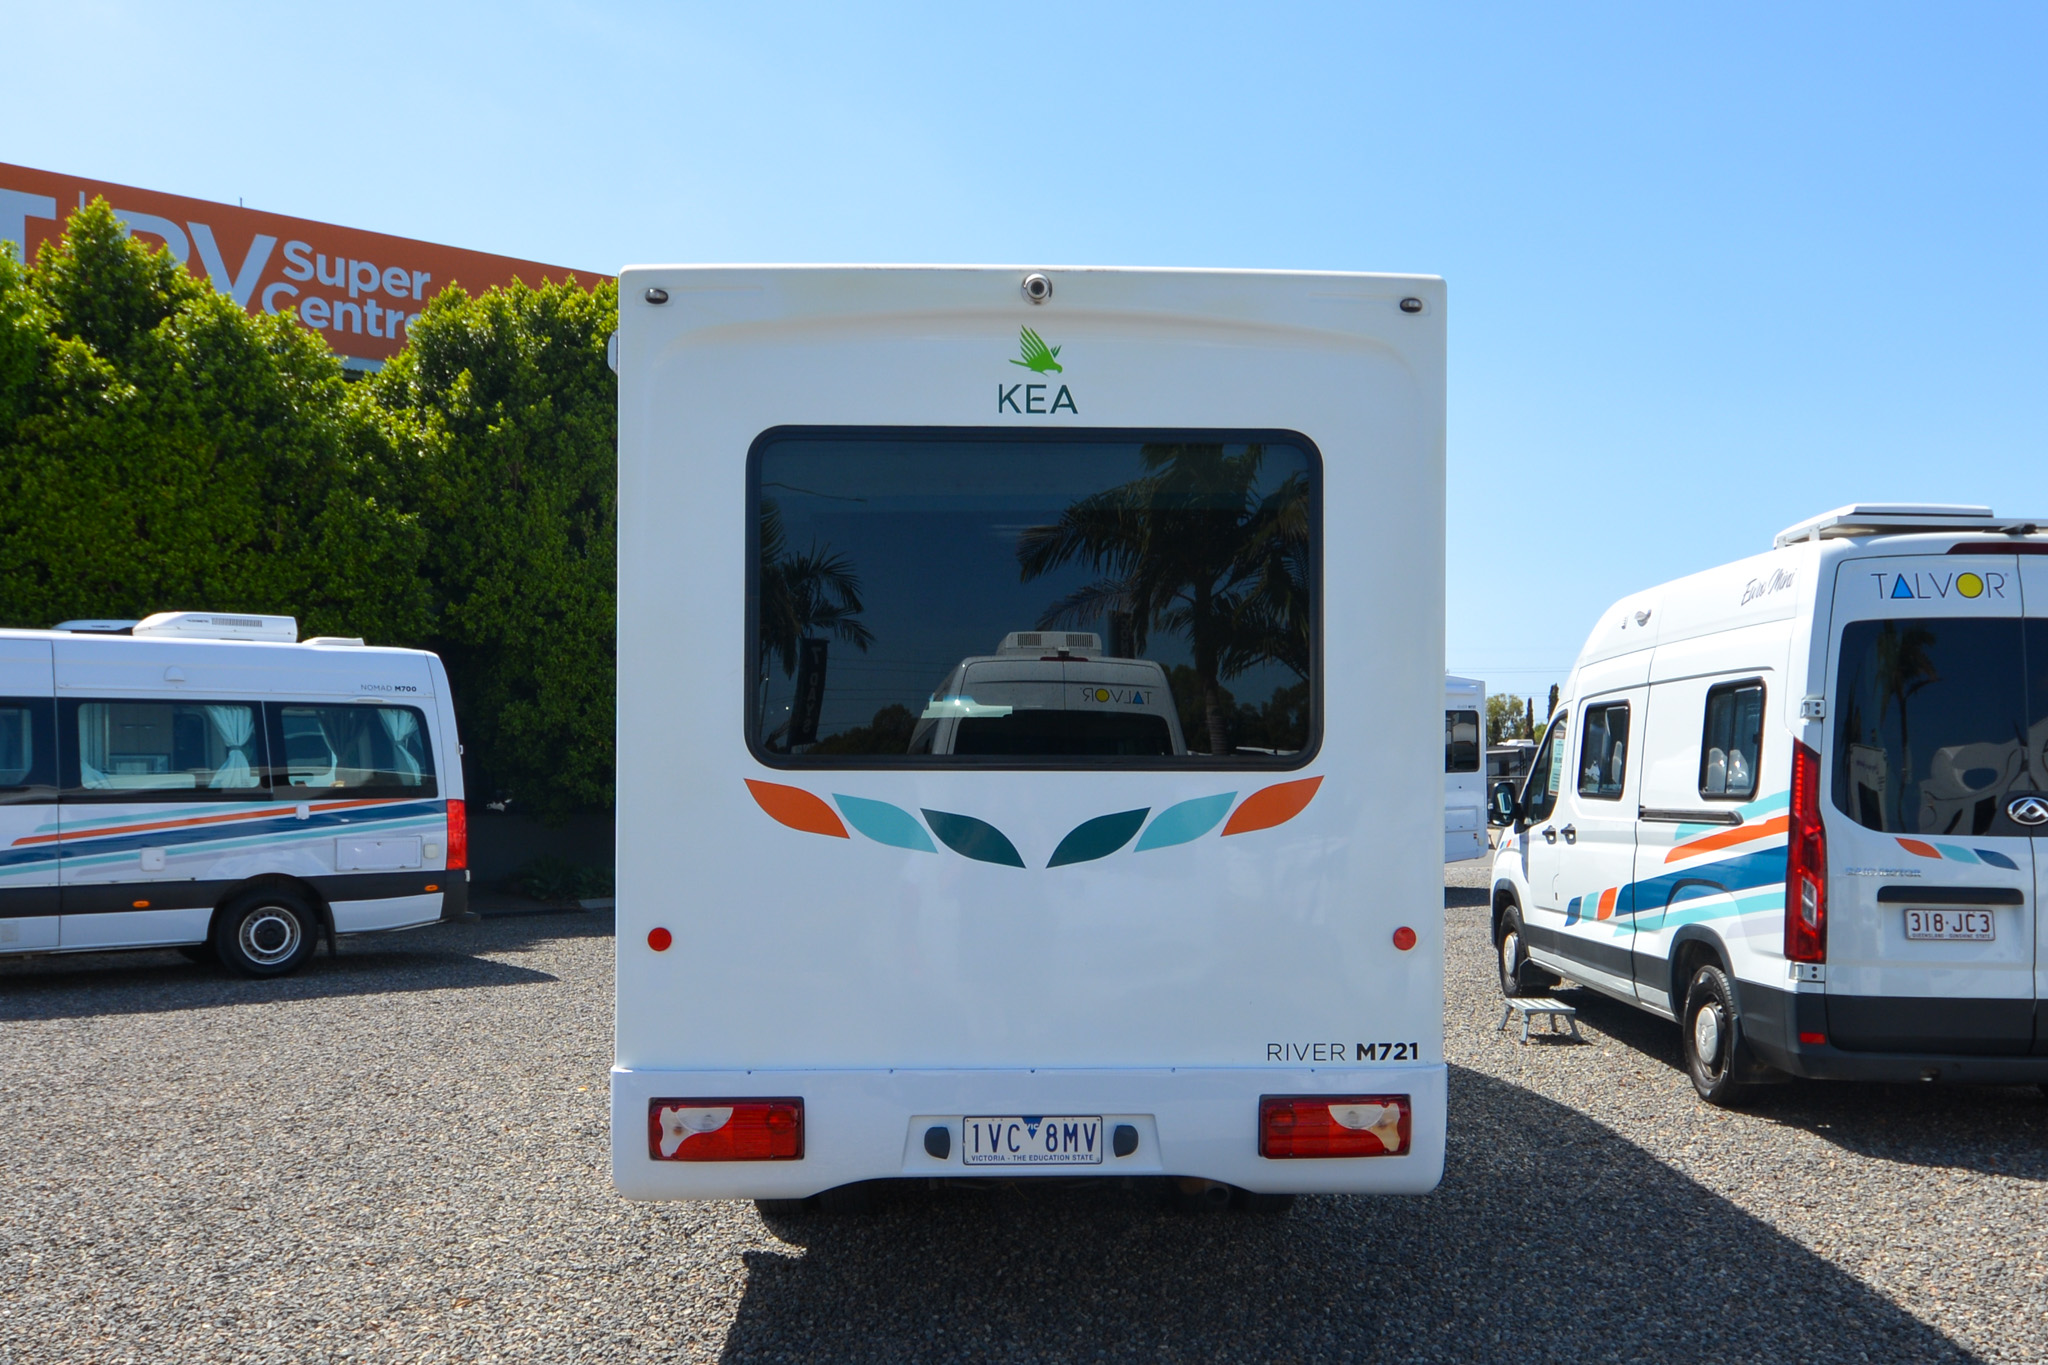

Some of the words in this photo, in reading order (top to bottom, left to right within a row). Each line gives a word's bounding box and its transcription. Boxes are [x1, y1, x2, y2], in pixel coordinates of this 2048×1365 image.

[282, 240, 431, 300] Super
[998, 383, 1079, 414] KEA
[1870, 572, 2005, 599] TALVOR
[1266, 1043, 1346, 1061] RIVER
[1356, 1042, 1418, 1061] M721
[972, 1123, 1021, 1153] 1VC
[1045, 1123, 1097, 1153] 8MV
[971, 1154, 1006, 1162] VICTORIA
